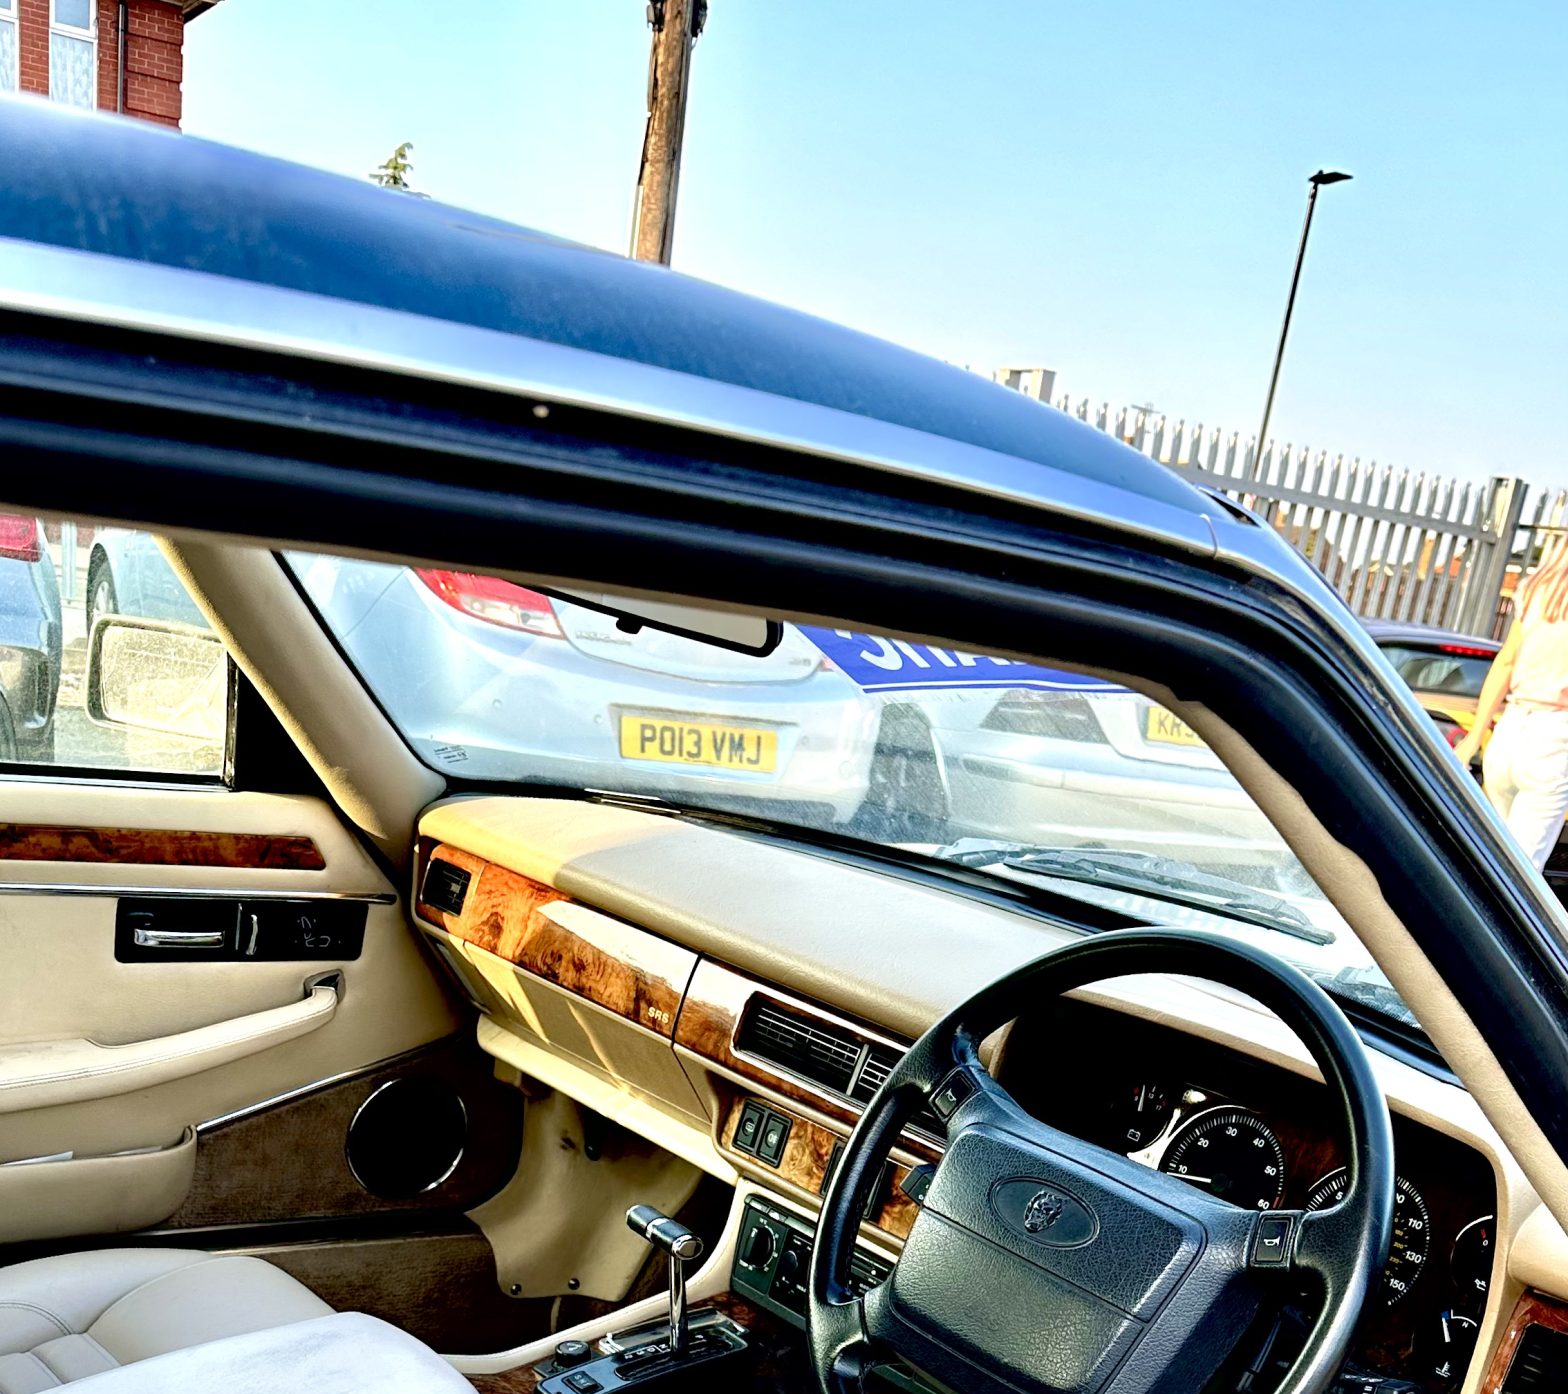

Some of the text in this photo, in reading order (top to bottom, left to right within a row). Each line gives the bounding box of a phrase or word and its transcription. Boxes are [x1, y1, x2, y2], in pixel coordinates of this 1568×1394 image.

[639, 723, 762, 766] PO13 VMJ
[648, 1006, 670, 1024] SRS
[1225, 1126, 1238, 1137] 30
[1197, 1137, 1210, 1148] 20
[1252, 1137, 1265, 1148] 40
[1178, 1164, 1188, 1174] 10
[1264, 1165, 1277, 1176] 50
[1257, 1198, 1270, 1210] 60
[1408, 1217, 1423, 1230] 110
[1405, 1250, 1422, 1264] 130
[1389, 1278, 1406, 1291] 150
